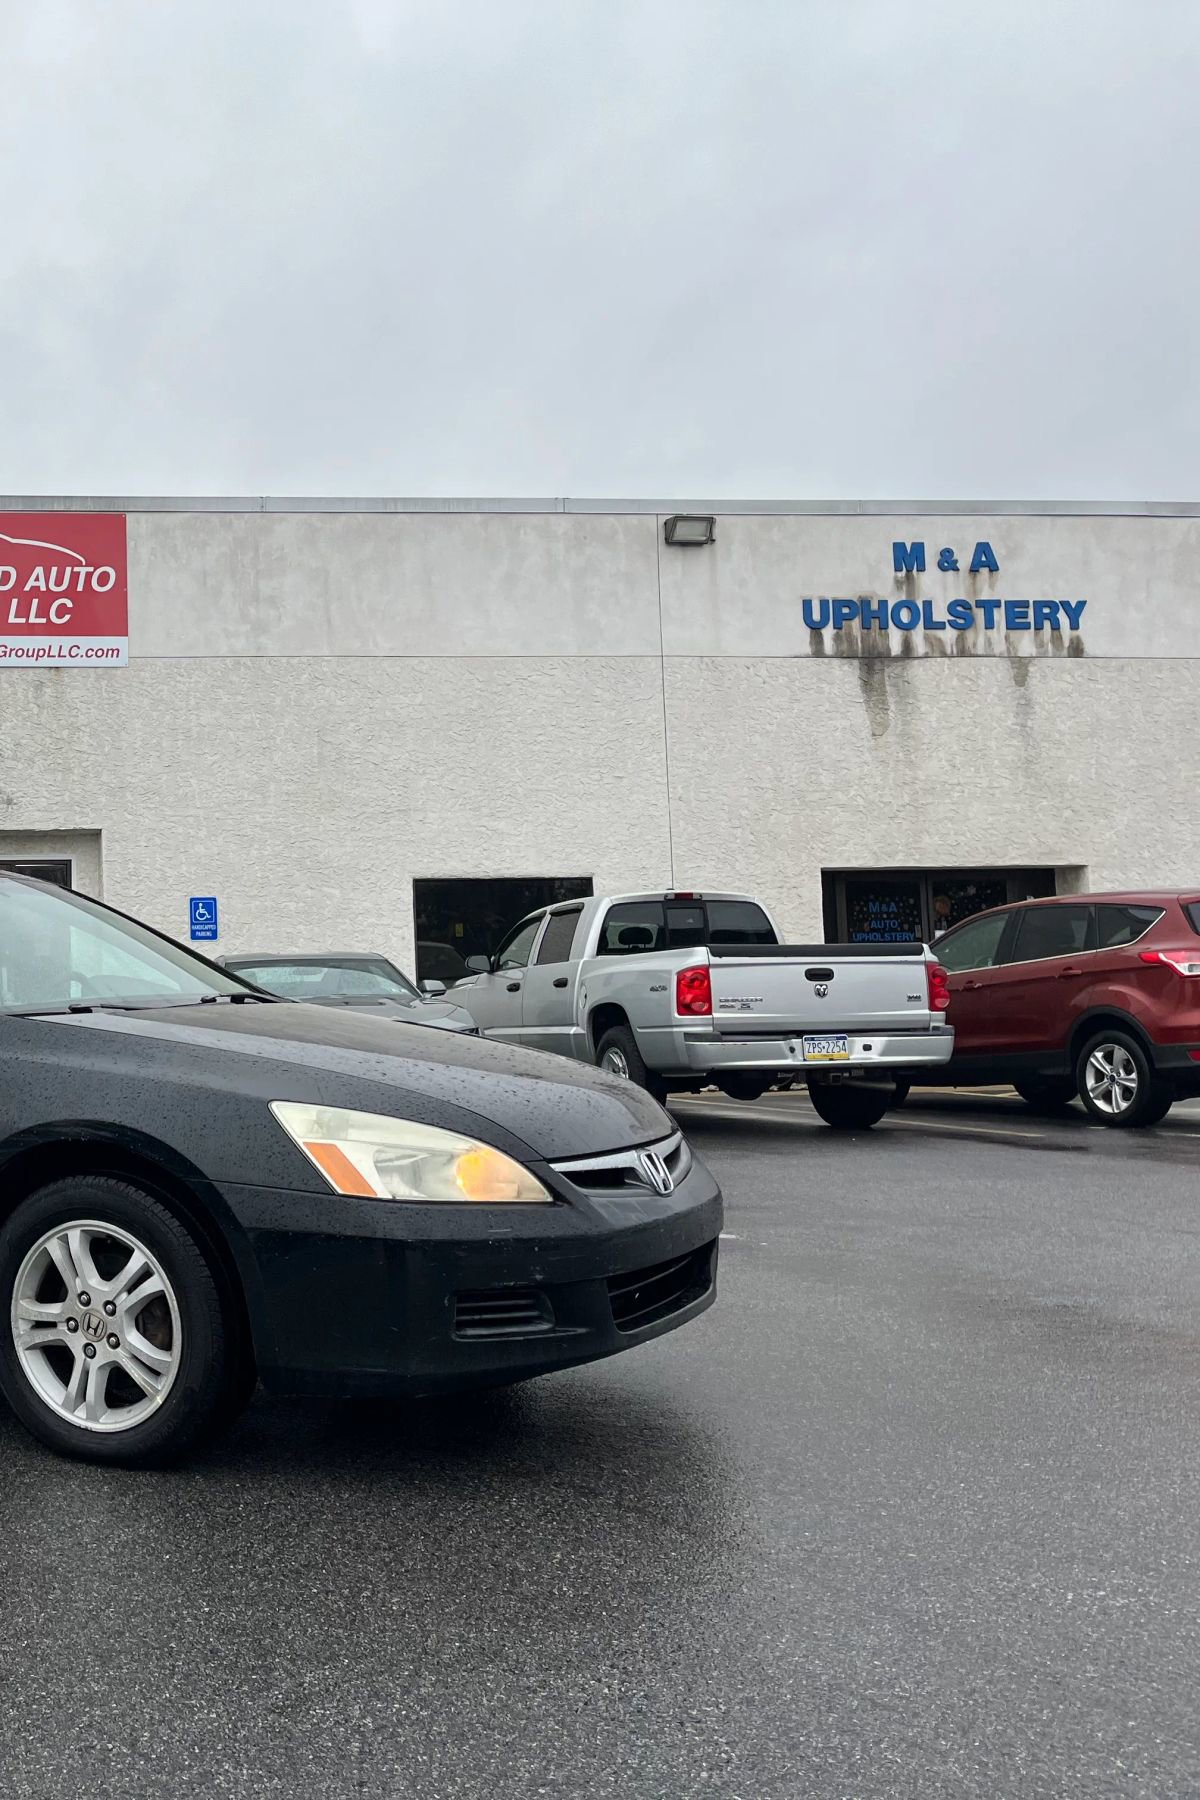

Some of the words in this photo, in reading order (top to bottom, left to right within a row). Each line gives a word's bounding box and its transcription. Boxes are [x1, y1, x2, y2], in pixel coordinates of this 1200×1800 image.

[892, 541, 926, 572] M
[937, 547, 960, 572] &
[969, 541, 1000, 573] A
[23, 565, 117, 592] AUTO
[7, 597, 74, 624] LLC
[802, 599, 1088, 631] UPHOLSTERY
[852, 932, 915, 942] UPHOLSTERY
[870, 919, 898, 929] AUTO
